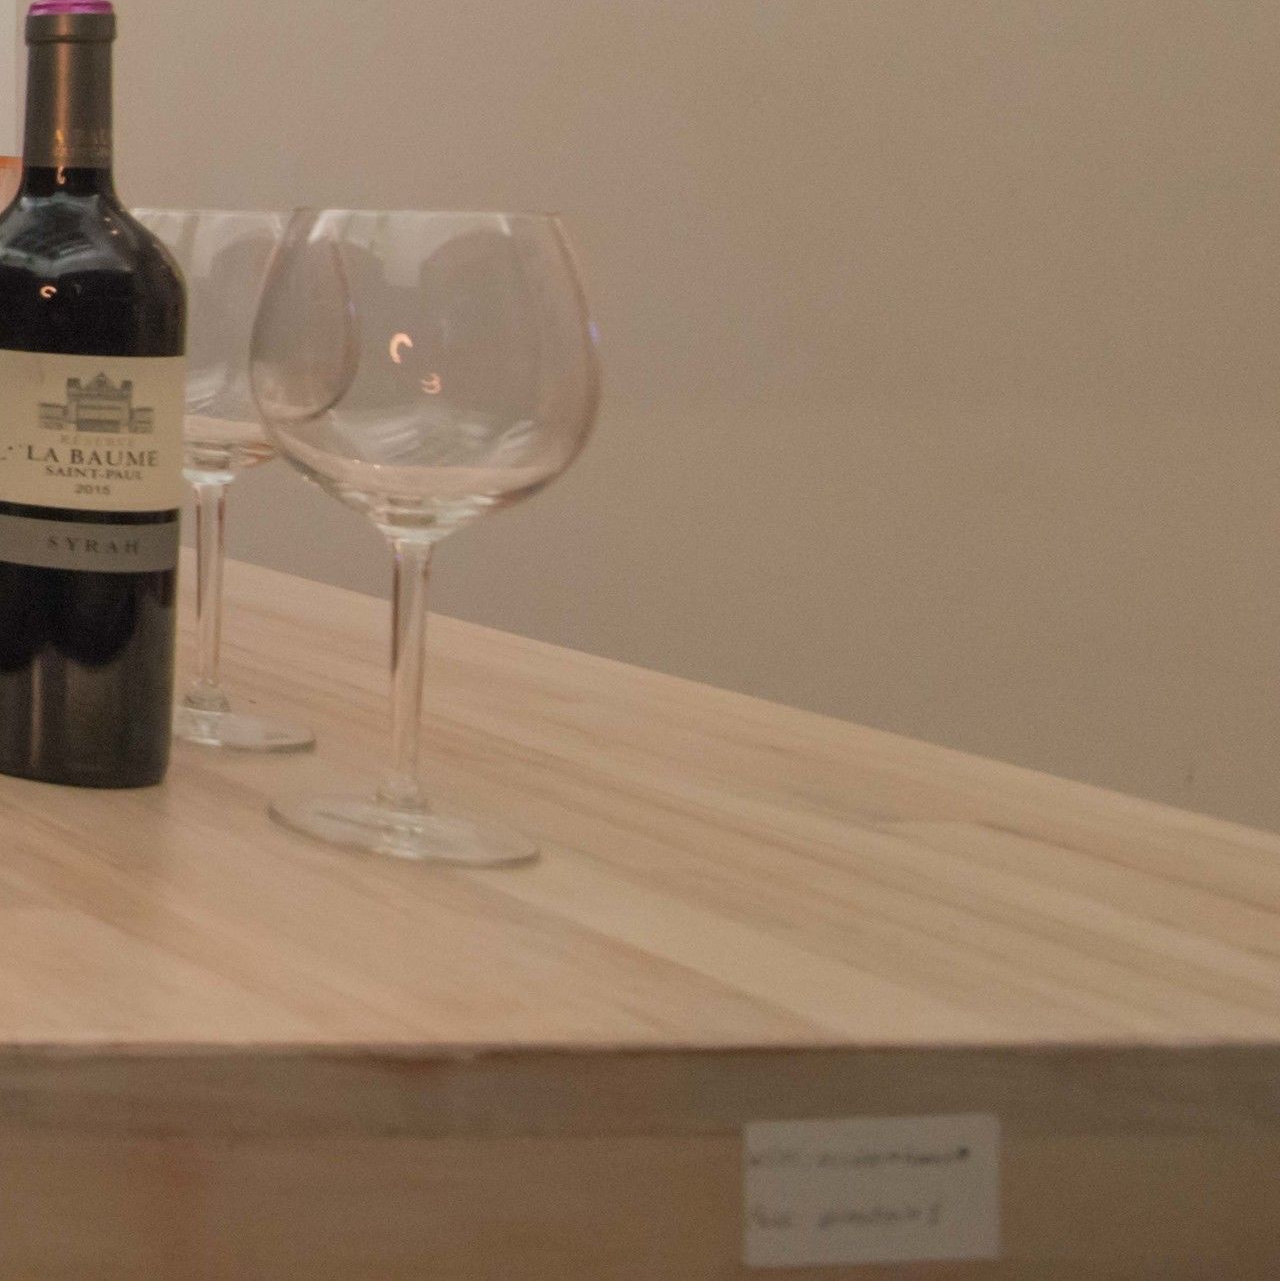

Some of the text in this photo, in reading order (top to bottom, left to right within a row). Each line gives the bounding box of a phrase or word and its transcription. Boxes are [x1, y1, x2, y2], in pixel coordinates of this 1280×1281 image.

[27, 445, 159, 467] LA BAUME
[44, 465, 144, 481] SAINT-PAUL
[47, 535, 139, 556] SYRAH
